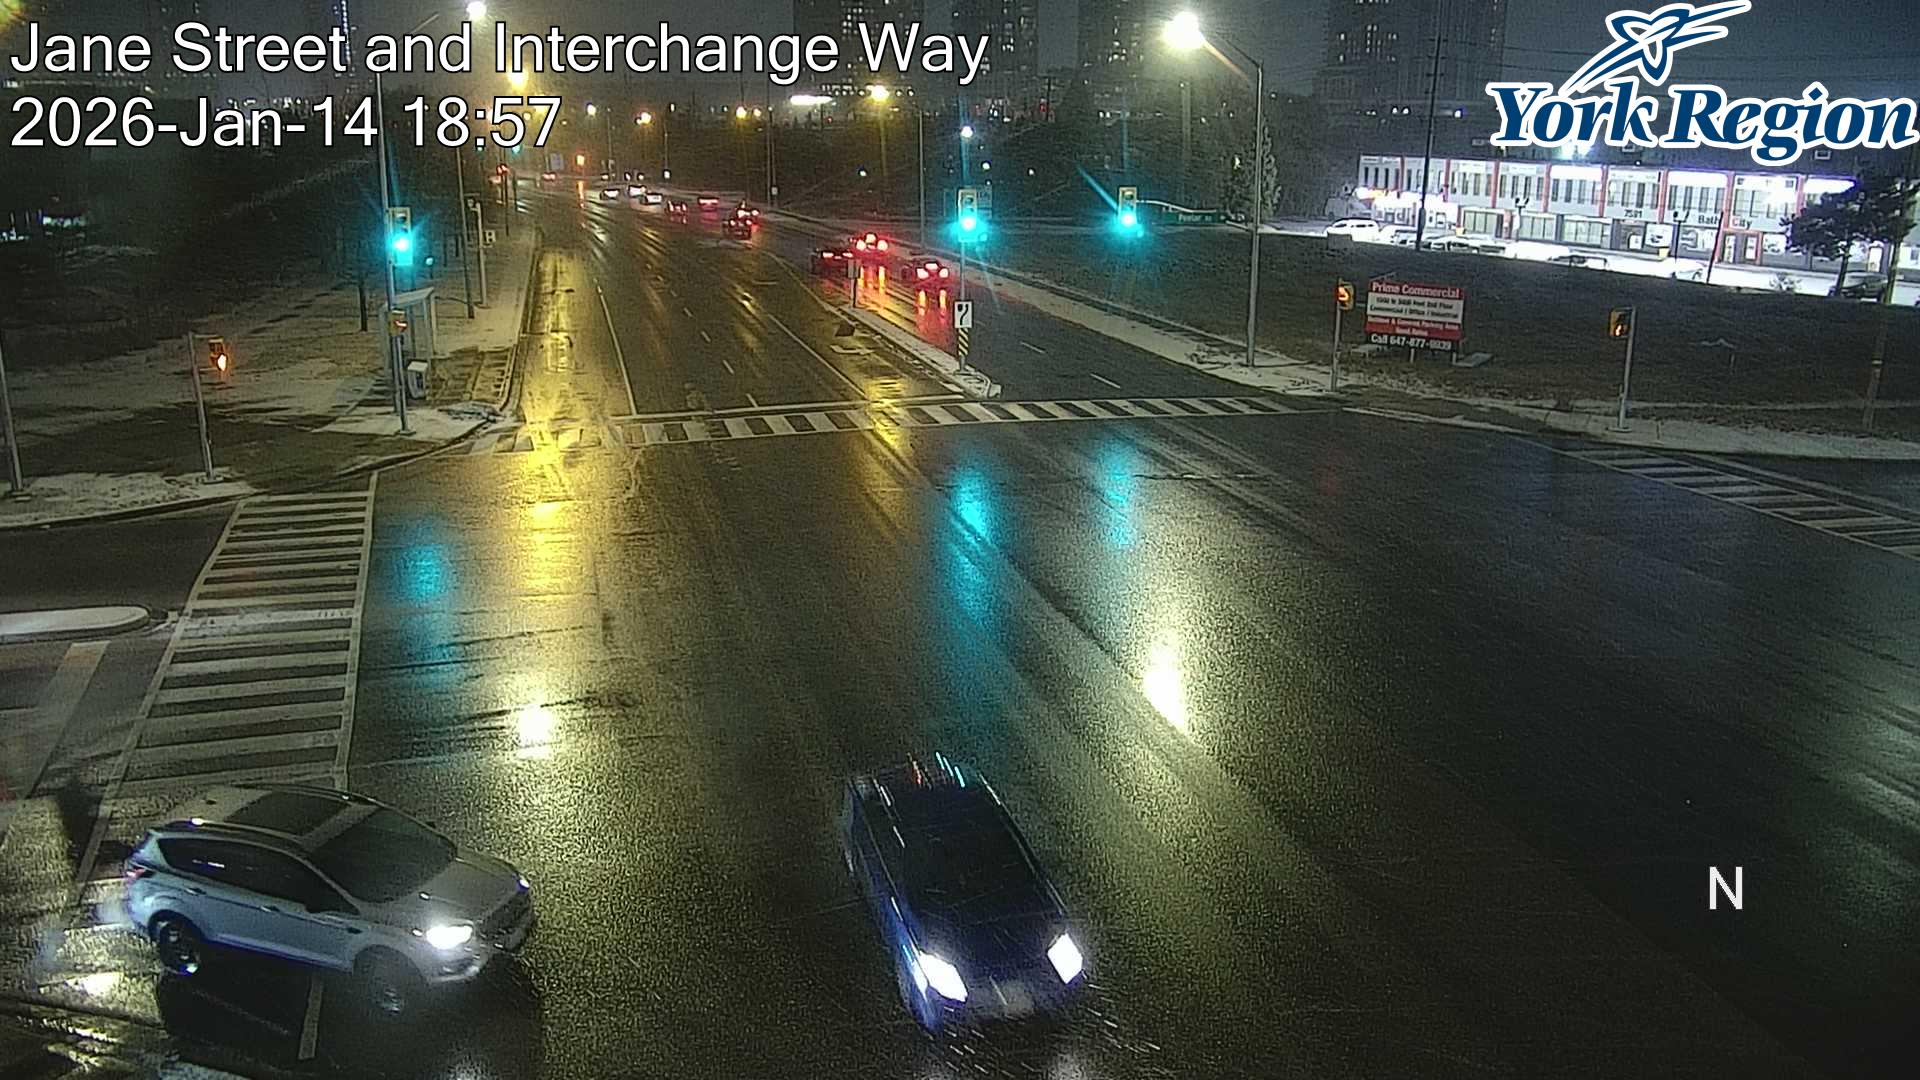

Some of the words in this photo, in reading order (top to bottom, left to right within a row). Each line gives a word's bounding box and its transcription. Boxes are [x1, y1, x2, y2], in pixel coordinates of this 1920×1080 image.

[1732, 218, 1752, 230] City
[1372, 282, 1400, 293] Prime
[1402, 284, 1460, 298] Commercial
[1371, 333, 1388, 344] Call
